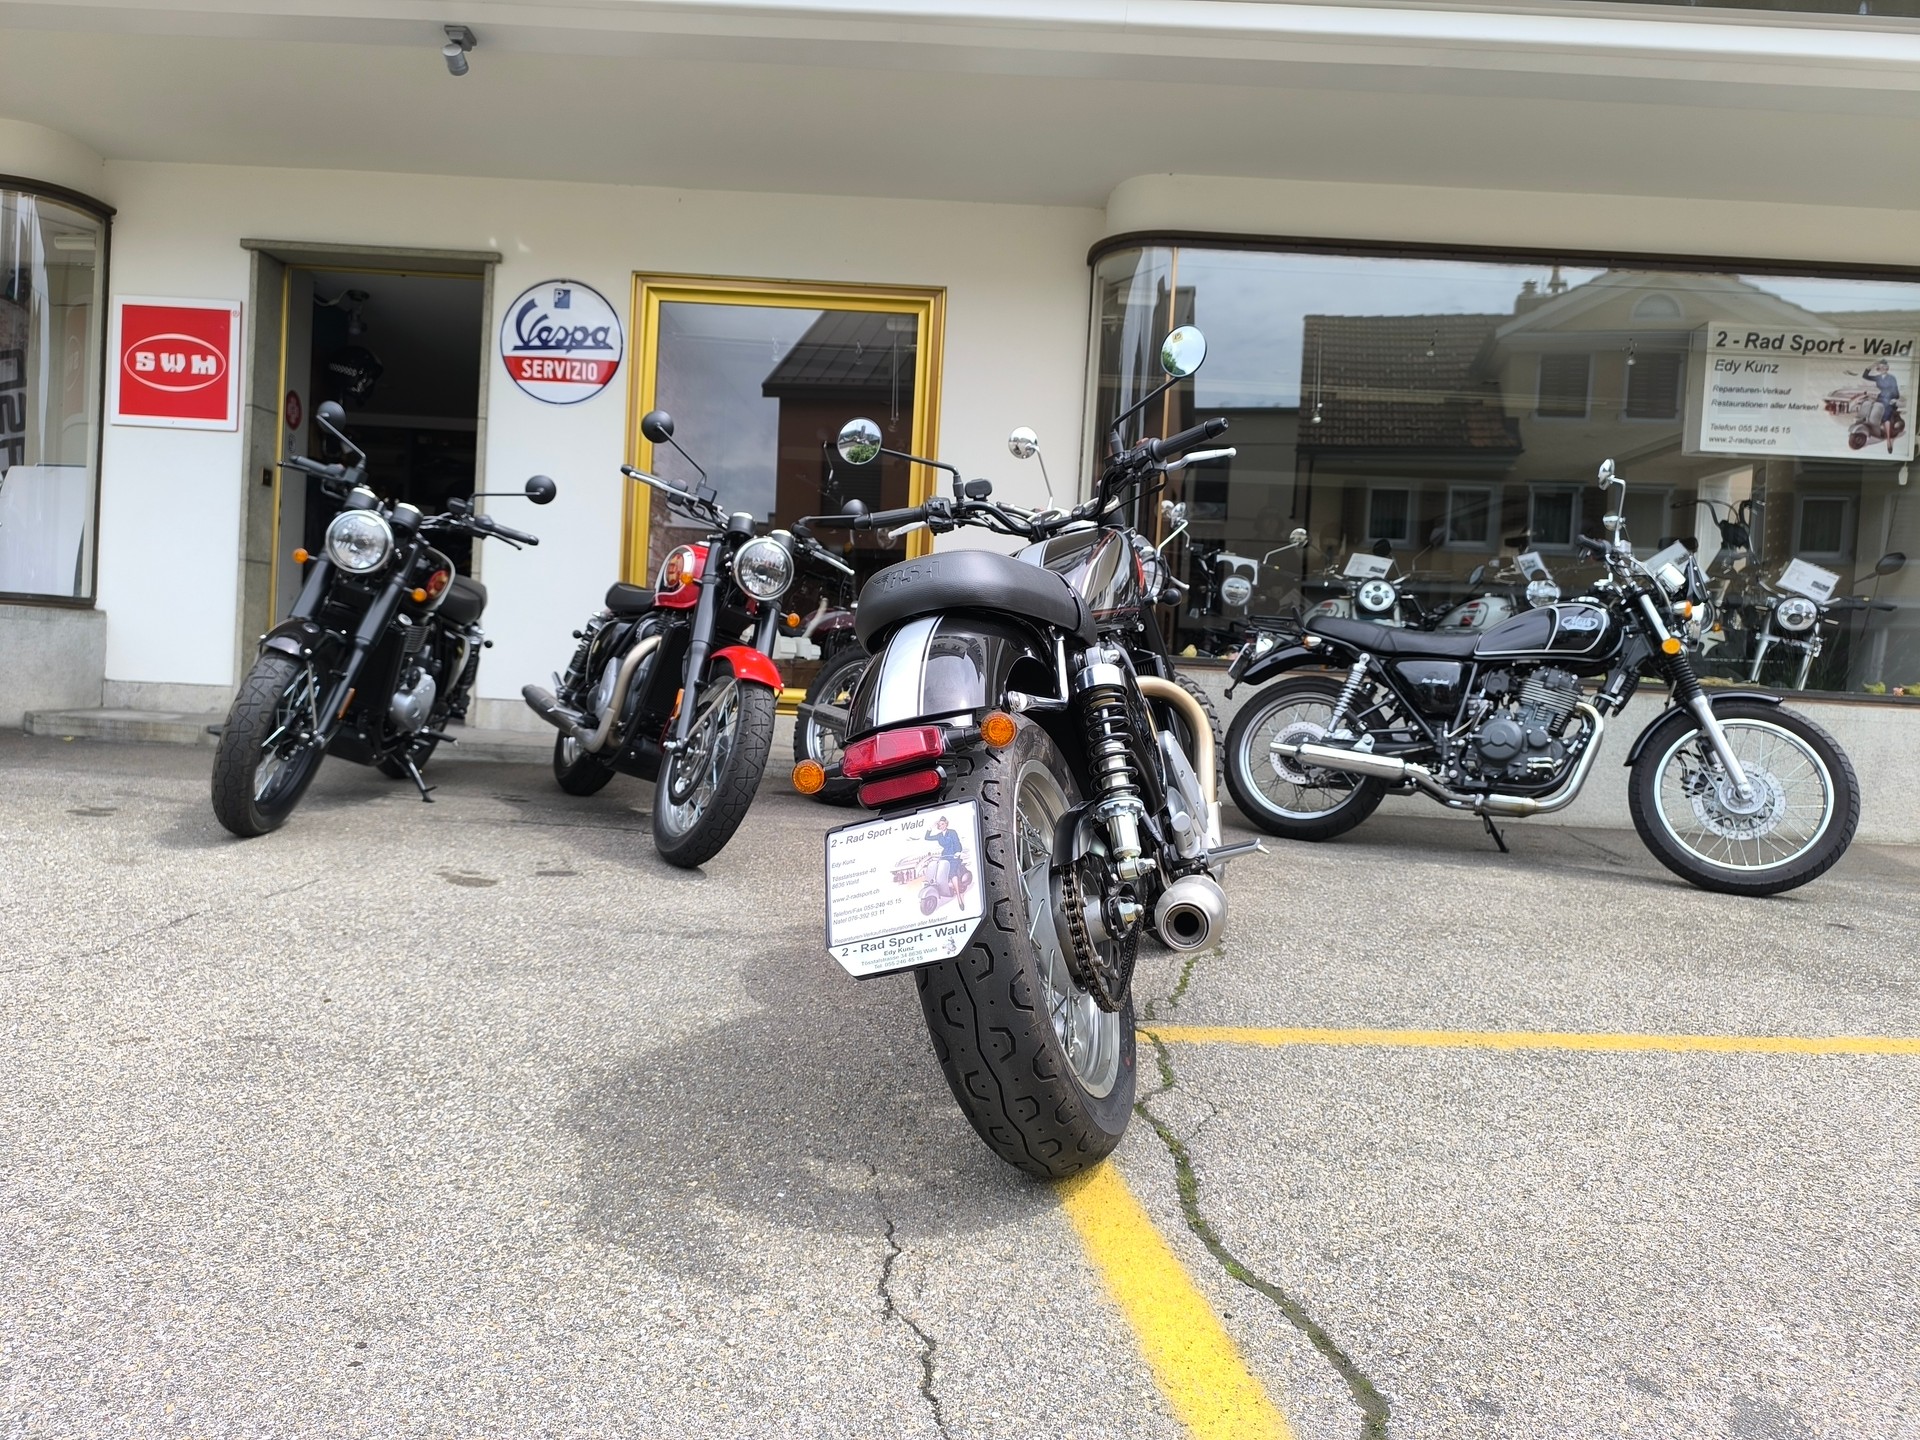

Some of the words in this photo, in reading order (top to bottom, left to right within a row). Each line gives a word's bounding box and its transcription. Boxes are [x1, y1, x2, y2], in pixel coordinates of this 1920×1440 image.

[512, 298, 613, 353] Vespa
[1716, 331, 1728, 347] 2
[1745, 332, 1784, 350] Rad
[1790, 335, 1844, 355] Sport
[1863, 338, 1913, 356] Wald
[135, 352, 216, 375] SWM
[521, 359, 598, 381] SERVIZIO
[1714, 359, 1741, 374] Edy
[1744, 361, 1779, 374] Kunz
[1712, 385, 1791, 395] Reparaturen-Verkauf
[1711, 400, 1768, 409] Restaurationen
[1710, 423, 1737, 432] Telefon
[1709, 436, 1776, 446] www.2-radsport.ch
[831, 838, 837, 848] 2
[846, 832, 865, 844] Rad
[867, 826, 892, 842] Sport
[901, 819, 925, 832] Wald
[842, 948, 848, 956] 2
[861, 940, 884, 953] Rad
[889, 932, 923, 947] Sport
[935, 924, 966, 937] Wald
